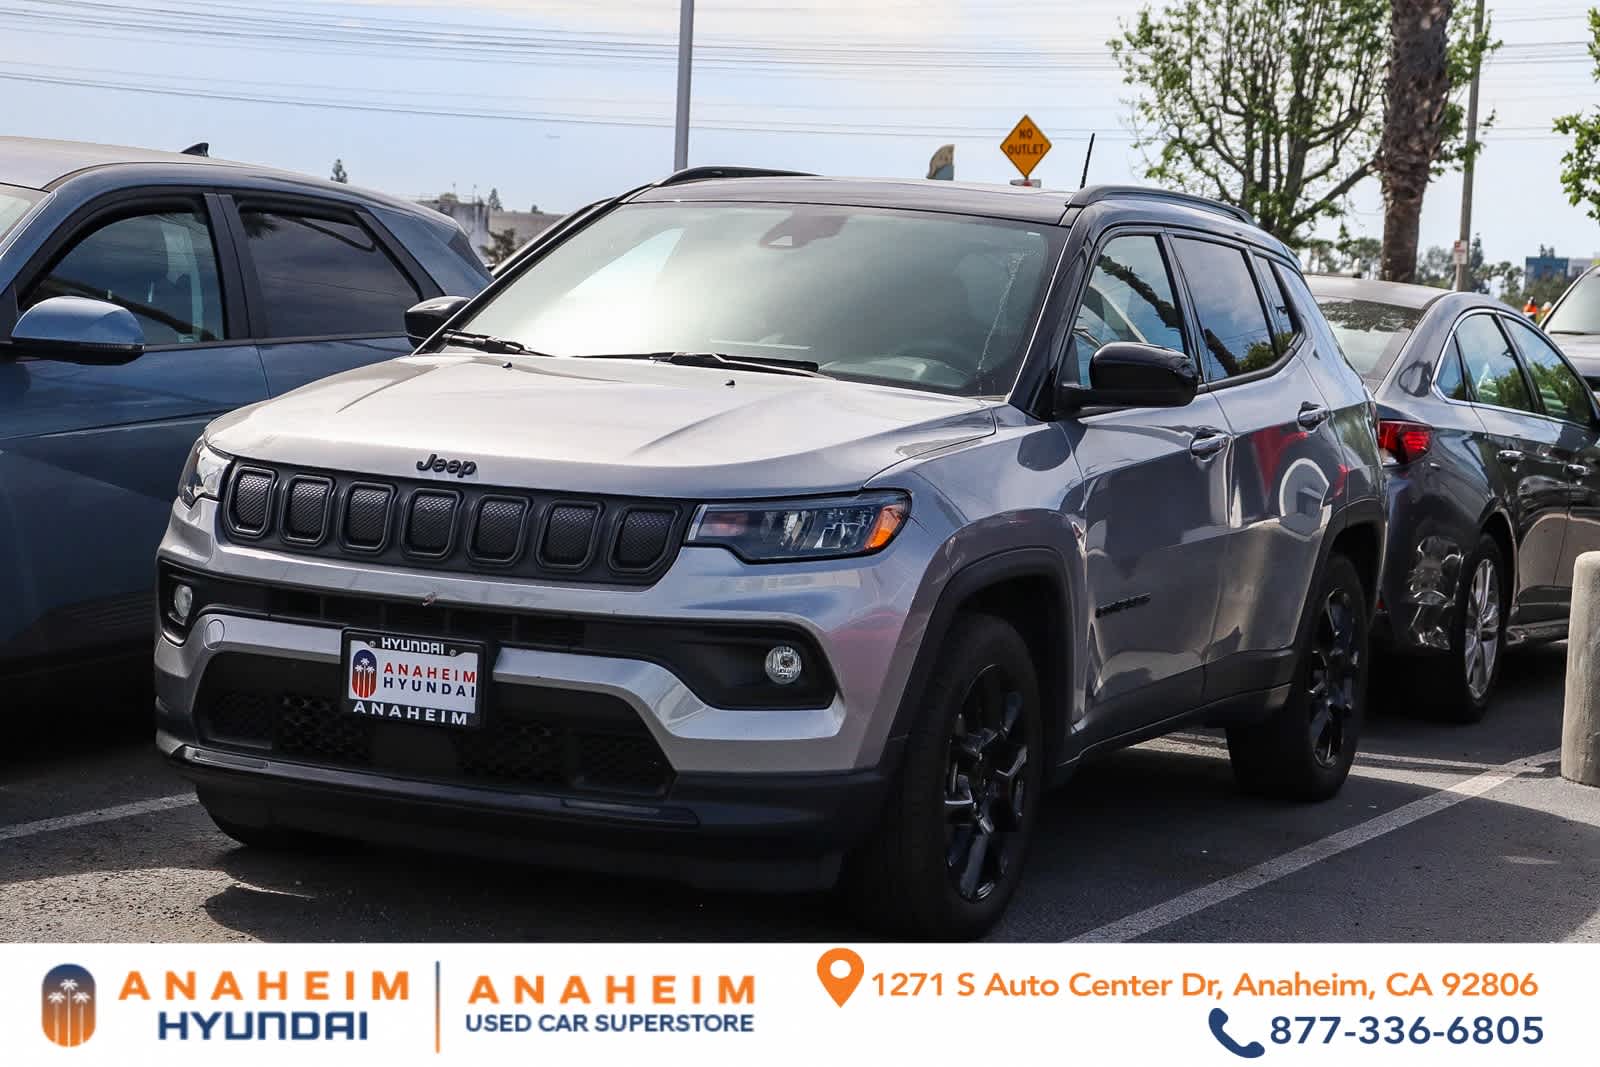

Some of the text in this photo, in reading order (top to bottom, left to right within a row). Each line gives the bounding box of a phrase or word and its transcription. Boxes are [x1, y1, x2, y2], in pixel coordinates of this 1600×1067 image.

[1019, 128, 1033, 139] NO
[1007, 143, 1044, 154] OUTLET
[416, 453, 477, 478] Jeep
[381, 637, 445, 655] HYUNDAI
[384, 662, 476, 683] ANAHEIM
[383, 677, 475, 698] HYUNDAI
[353, 701, 467, 726] ANAHEIM
